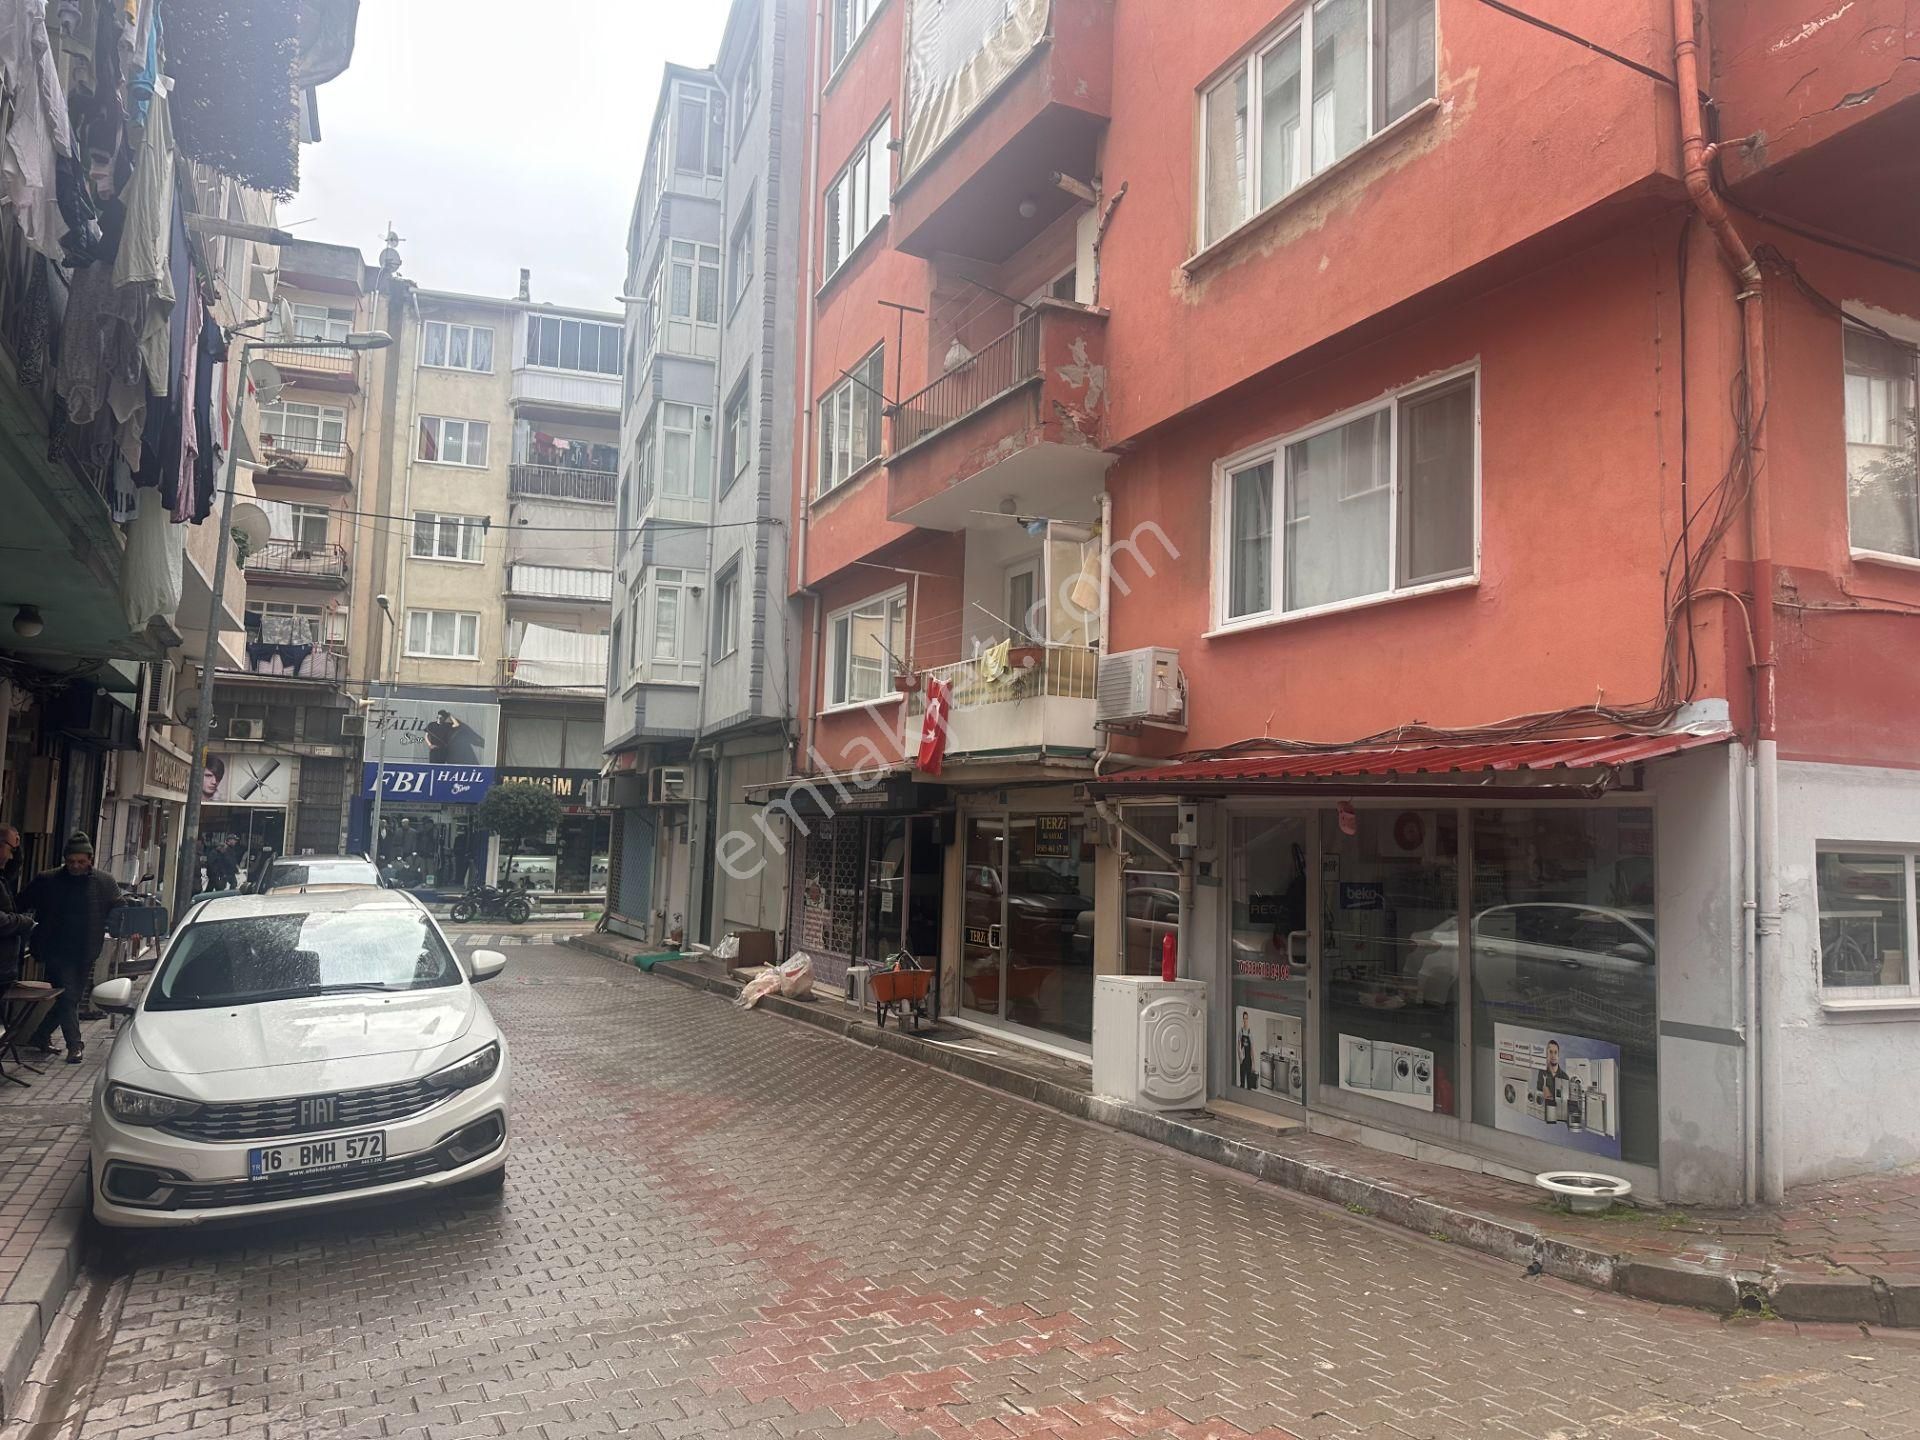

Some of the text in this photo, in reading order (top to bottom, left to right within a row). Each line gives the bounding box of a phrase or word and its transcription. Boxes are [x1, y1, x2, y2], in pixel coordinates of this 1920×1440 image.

[369, 771, 428, 793] FBI
[437, 769, 485, 783] HALİL
[1347, 887, 1377, 900] beko
[301, 1097, 337, 1126] FIAT
[263, 1135, 381, 1172] 16 BMH 572
